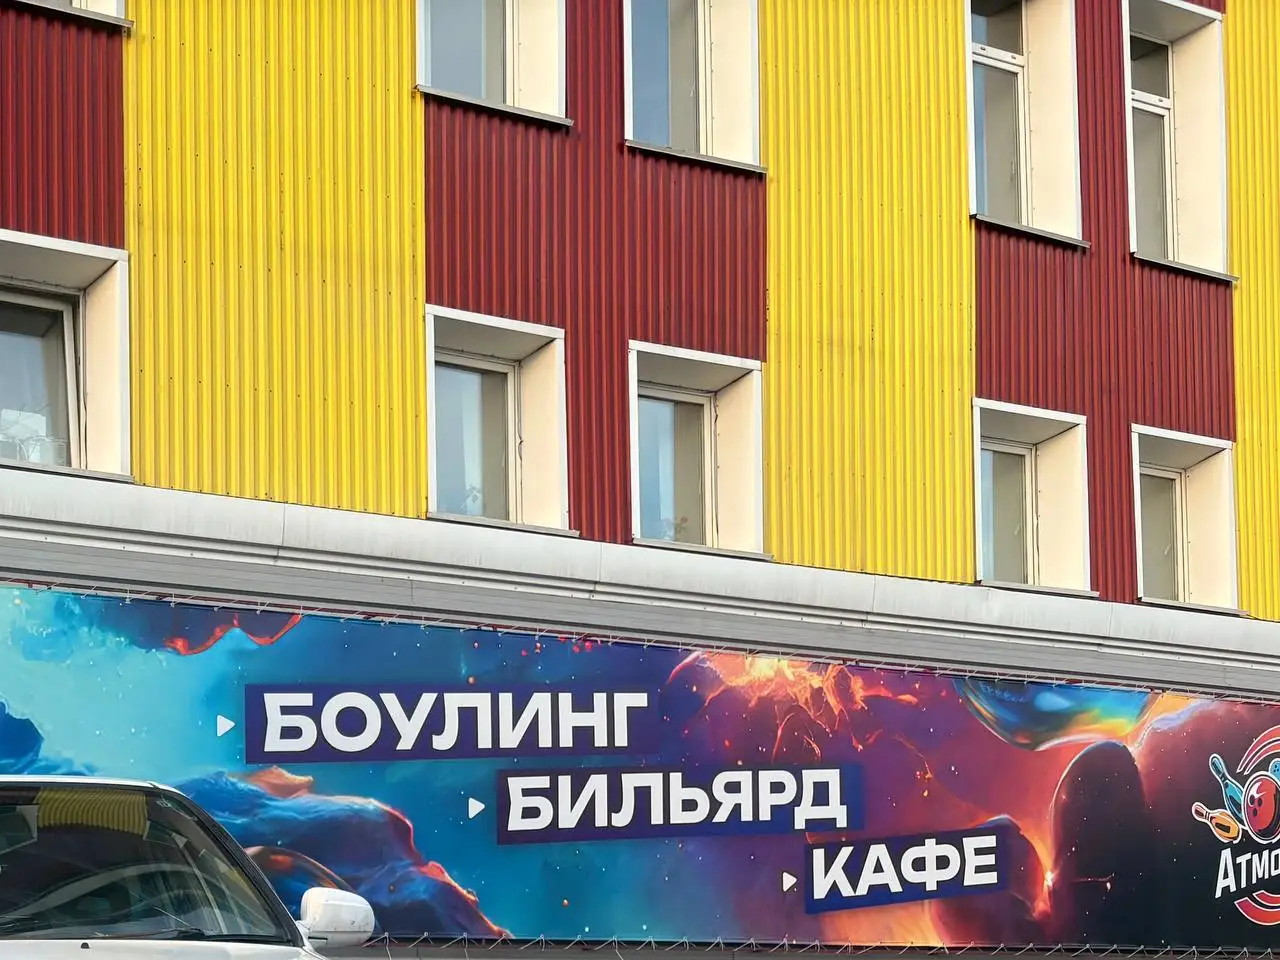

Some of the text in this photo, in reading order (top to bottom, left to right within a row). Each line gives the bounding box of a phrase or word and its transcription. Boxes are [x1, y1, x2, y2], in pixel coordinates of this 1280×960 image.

[262, 690, 650, 754] БОУЛИНГ
[506, 767, 848, 832] БИЛЬЯРД
[811, 834, 999, 901] КАФЕ
